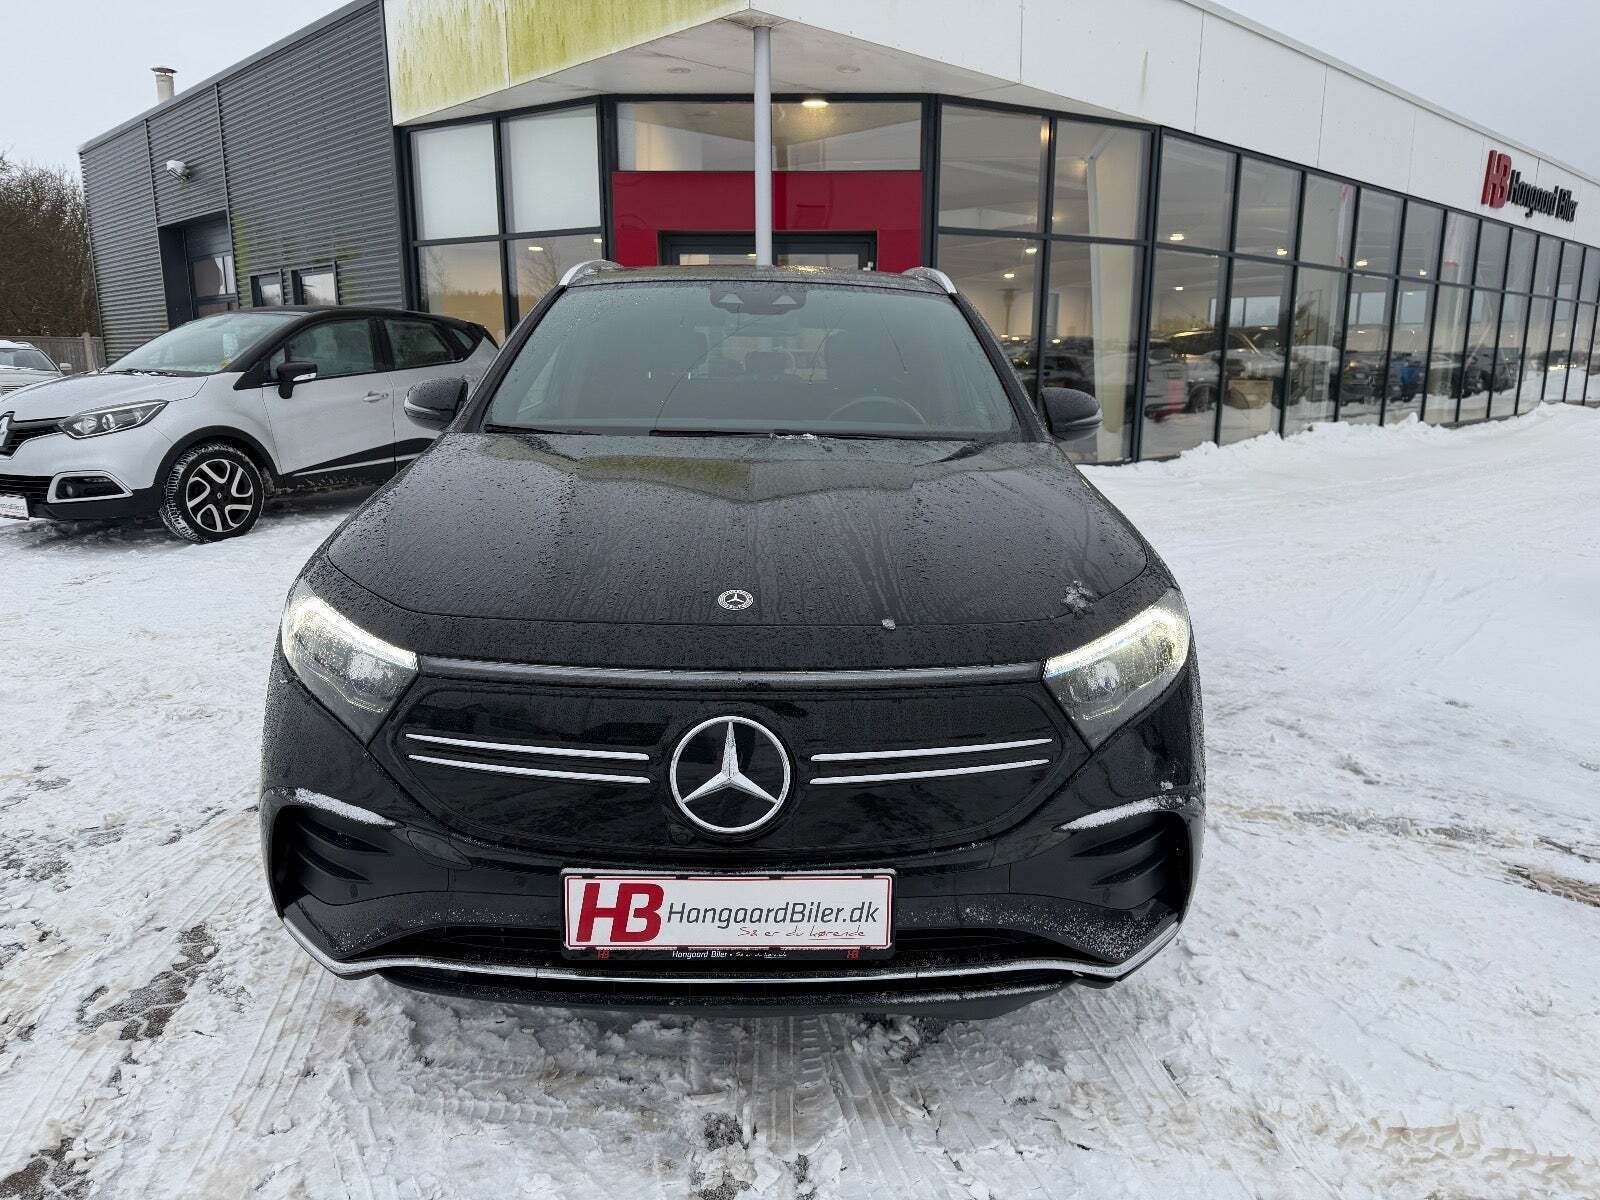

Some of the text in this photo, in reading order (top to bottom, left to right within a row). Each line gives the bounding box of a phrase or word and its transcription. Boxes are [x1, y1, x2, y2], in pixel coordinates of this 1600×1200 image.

[1481, 150, 1578, 222] HB Hangaard Biler
[576, 883, 879, 942] HB HangaardBiler.dk
[672, 950, 708, 959] Hangaard
[711, 950, 727, 958] Biler
